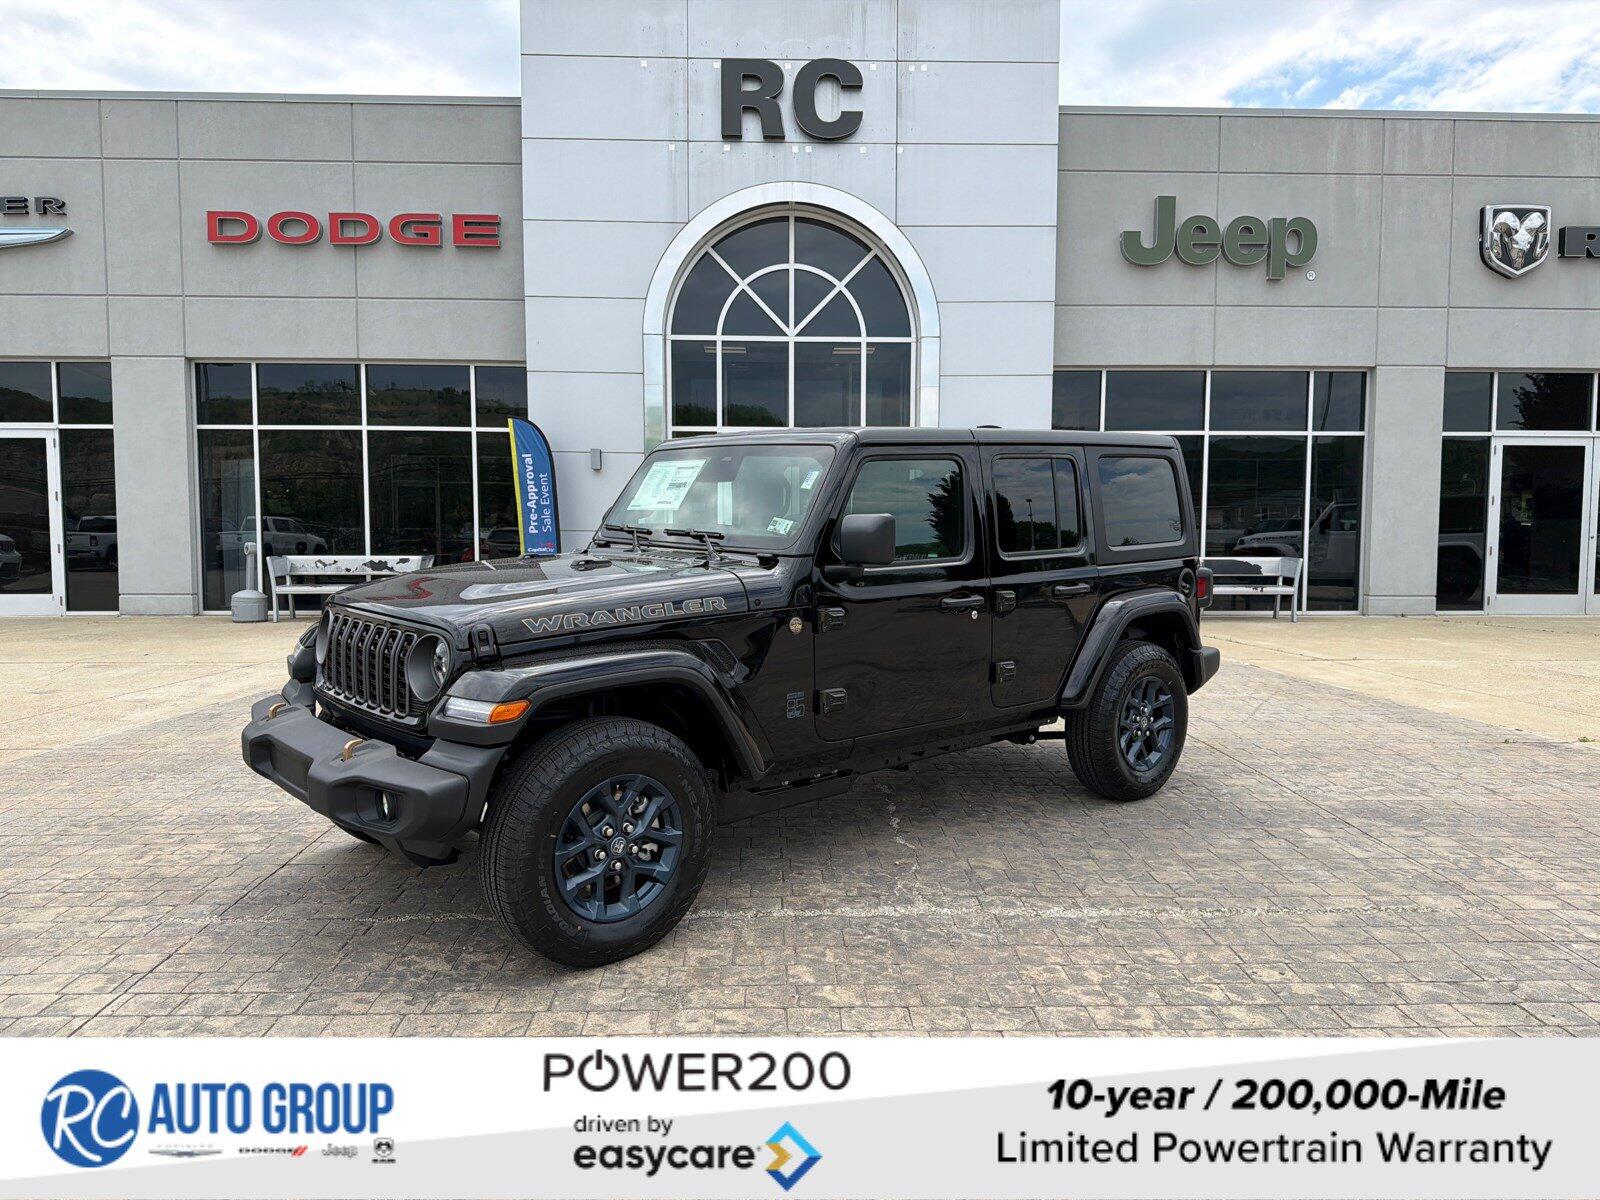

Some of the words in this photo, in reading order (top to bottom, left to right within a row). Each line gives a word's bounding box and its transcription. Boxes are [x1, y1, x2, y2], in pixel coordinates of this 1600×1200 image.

[721, 58, 864, 142] RC
[206, 209, 502, 249] DODGE
[1120, 195, 1319, 282] Jeep
[522, 454, 538, 534] Pre-Approval
[539, 473, 551, 505] Event
[541, 507, 552, 533] Sale
[522, 596, 728, 634] WRANGLER
